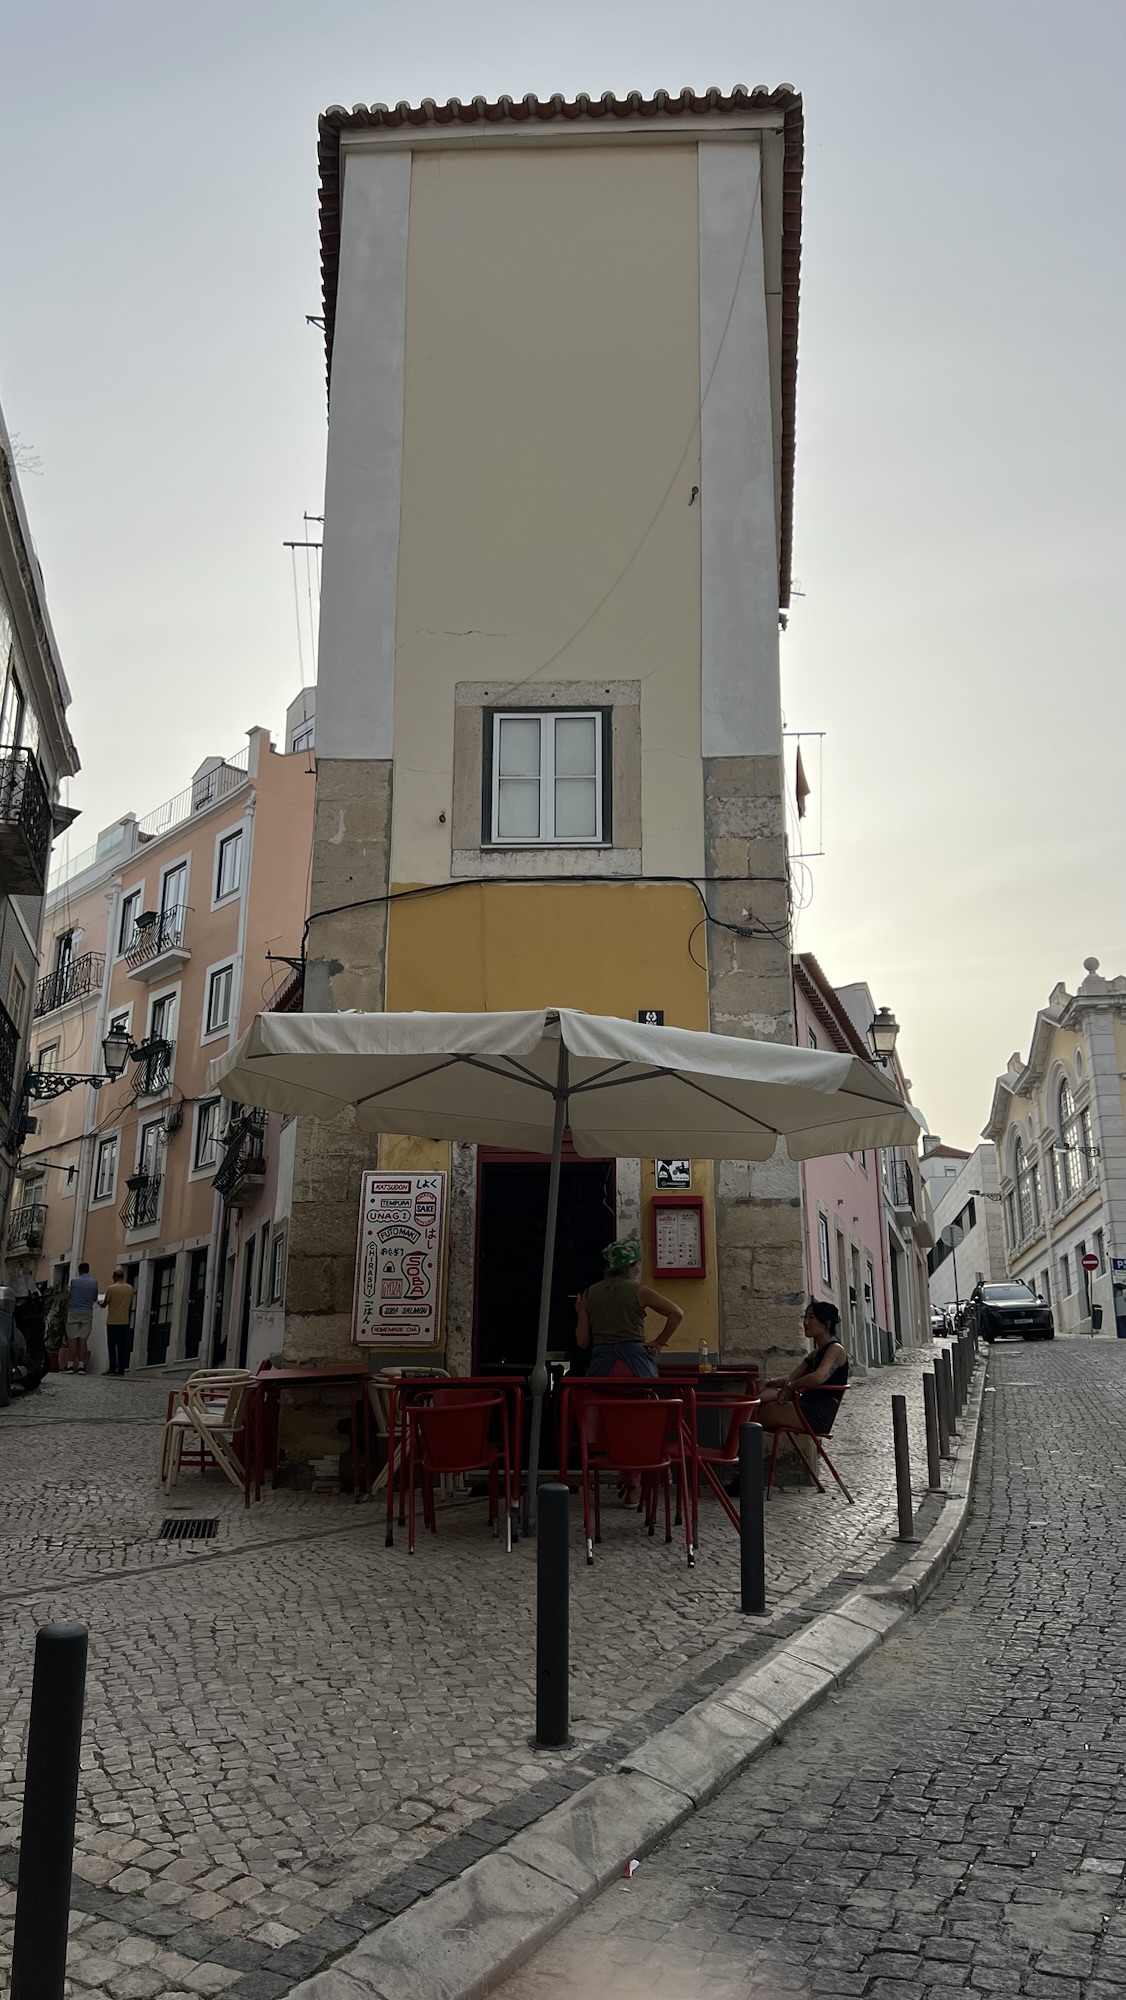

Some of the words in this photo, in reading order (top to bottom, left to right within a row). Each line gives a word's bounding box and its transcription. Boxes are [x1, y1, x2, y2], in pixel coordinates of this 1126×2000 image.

[369, 1212, 407, 1220] UNAGI
[416, 1205, 434, 1213] SAKE
[367, 1244, 375, 1295] CHIRASHI
[406, 1257, 424, 1295] SOBA
[383, 1281, 400, 1296] GYOZA
